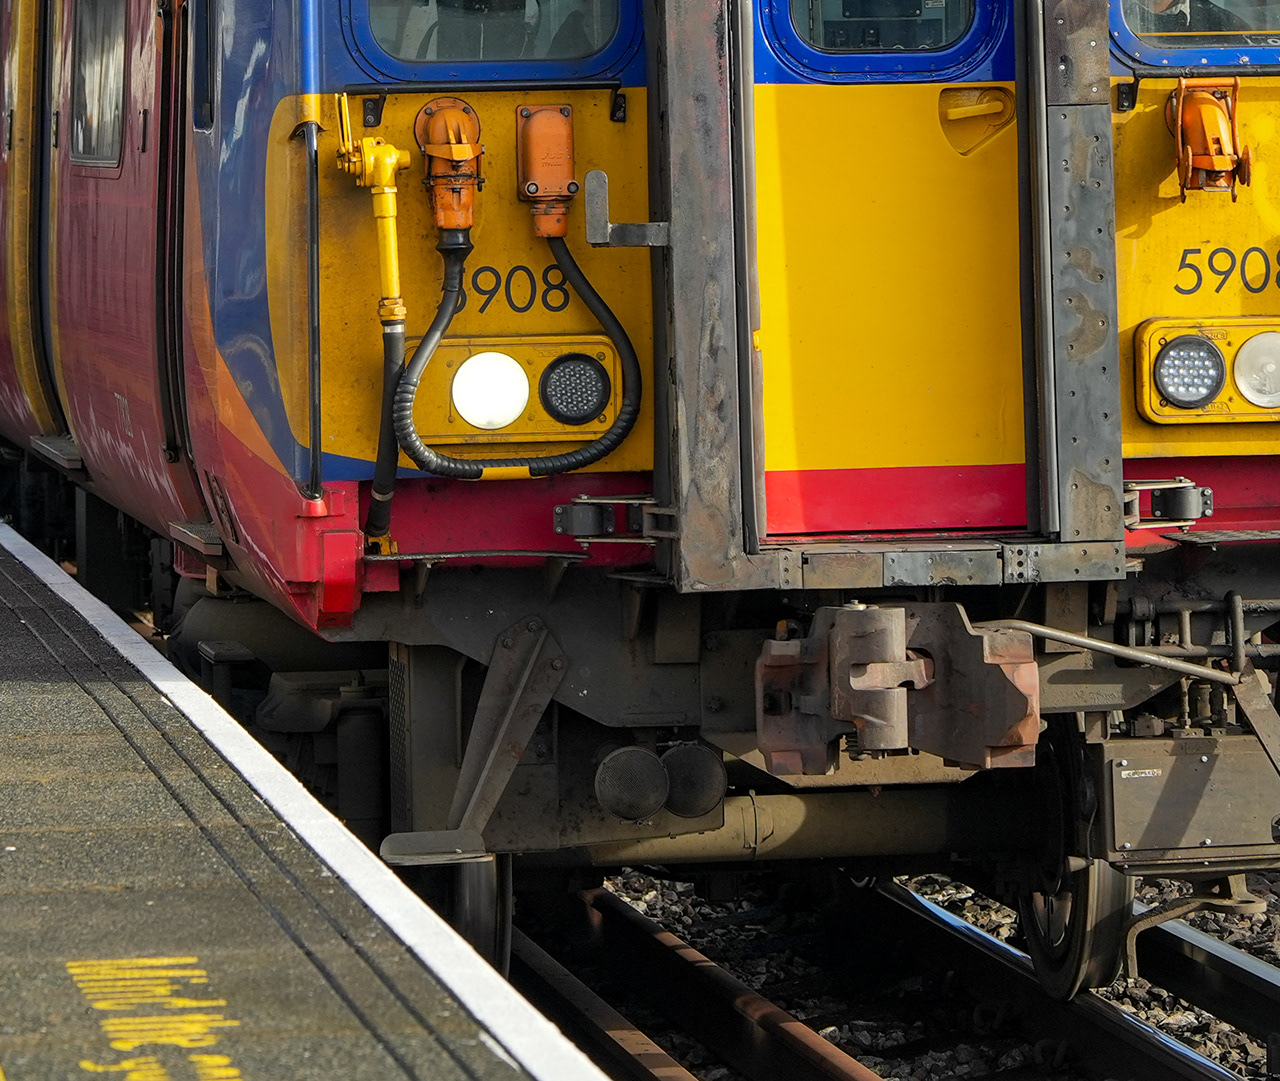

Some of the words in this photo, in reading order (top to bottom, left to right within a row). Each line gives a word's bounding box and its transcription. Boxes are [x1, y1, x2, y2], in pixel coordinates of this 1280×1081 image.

[454, 264, 570, 314] 908
[65, 956, 227, 1010] Mind
[99, 1013, 241, 1052] the
